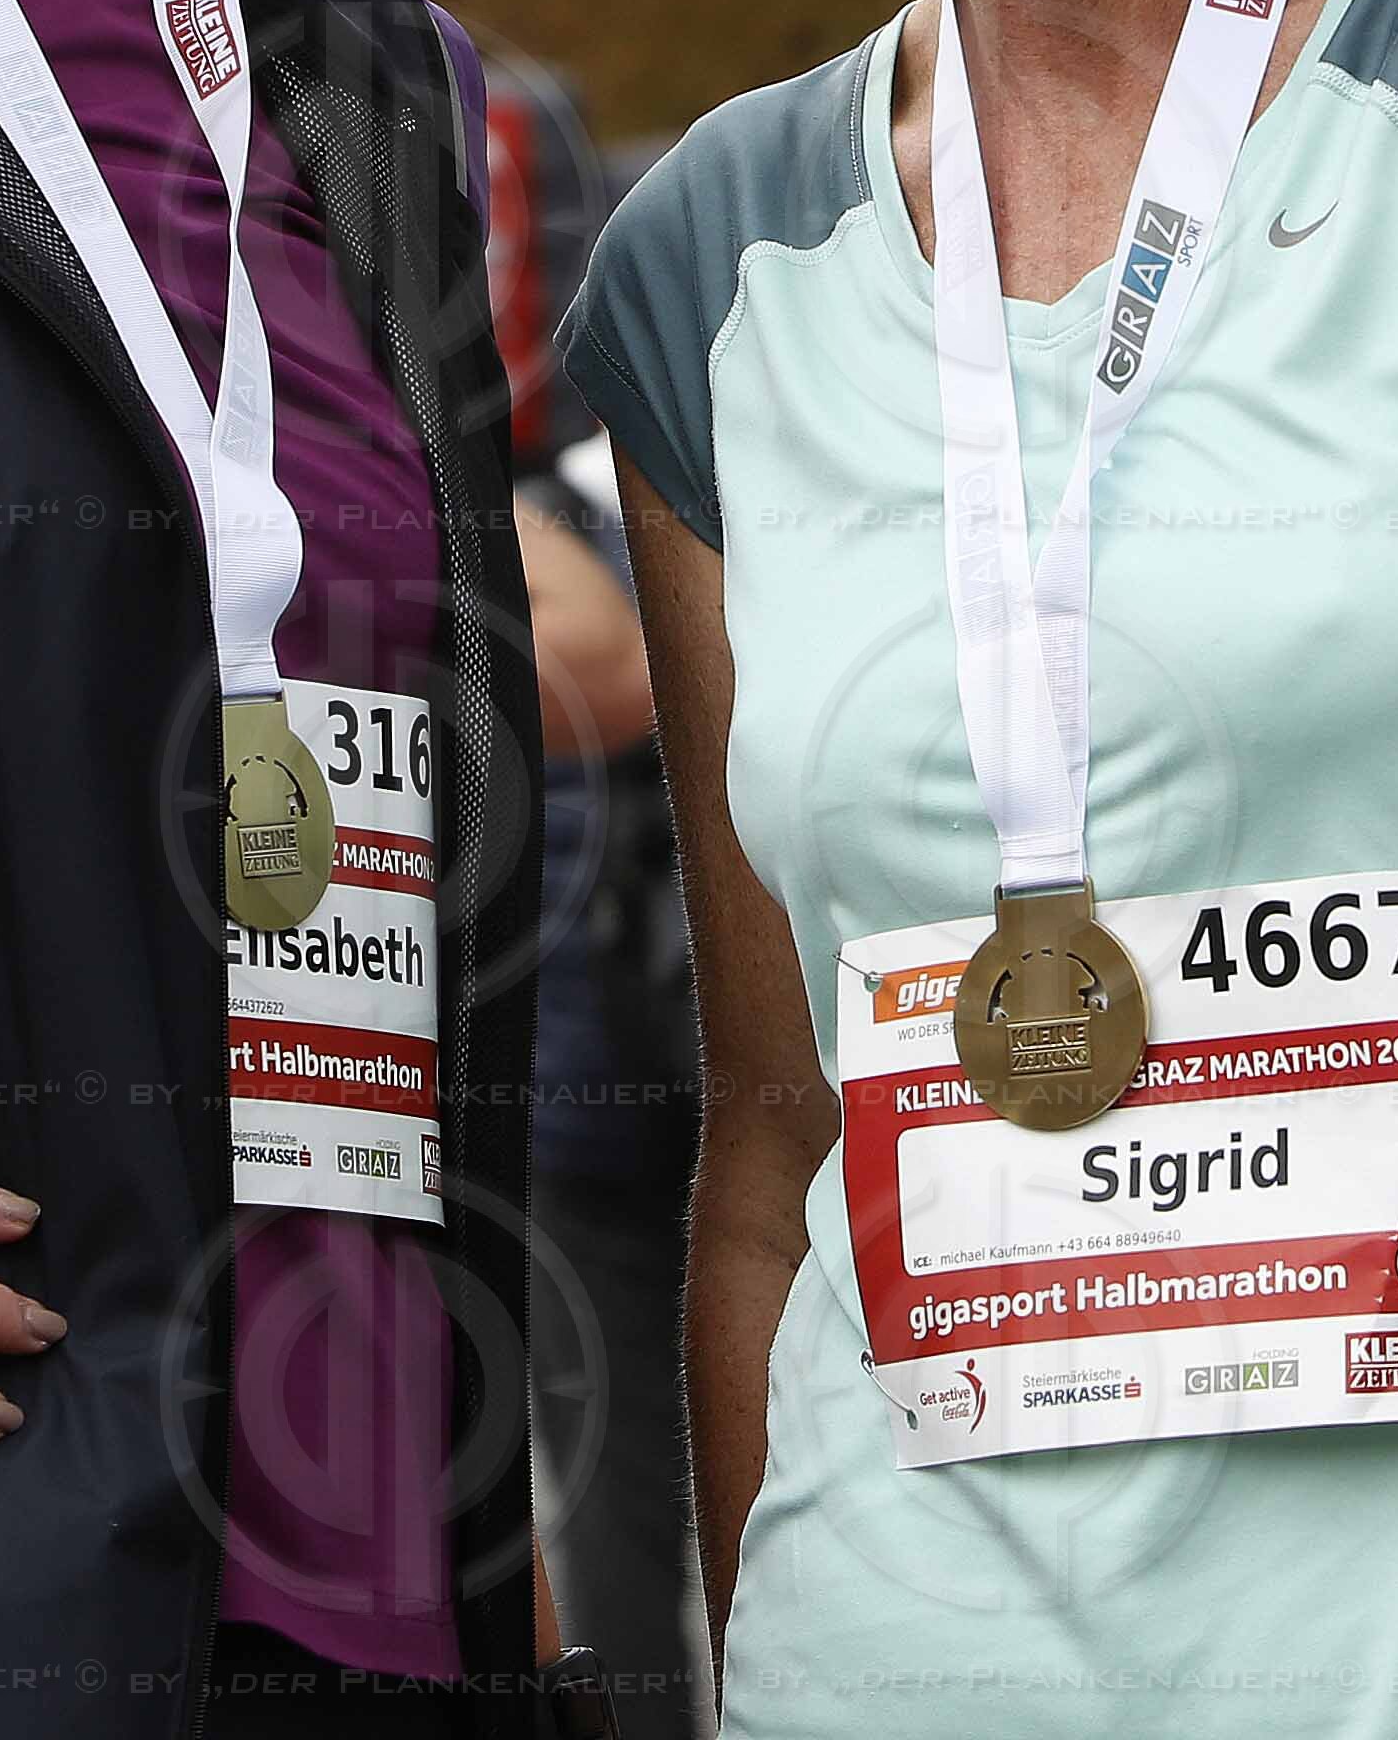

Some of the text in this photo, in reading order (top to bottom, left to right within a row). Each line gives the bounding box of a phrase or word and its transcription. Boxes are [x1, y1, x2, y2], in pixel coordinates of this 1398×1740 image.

[171, 0, 217, 93] ZEITUNG
[1177, 216, 1203, 267] SPORT
[1104, 207, 1182, 386] GRAZ
[243, 829, 298, 852] KLEINE
[245, 852, 301, 872] ZEITUNG
[343, 842, 431, 877] MARATHON
[897, 969, 962, 1013] giga
[897, 1026, 916, 1041] WO
[919, 1024, 941, 1039] DER
[1011, 1023, 1086, 1052] KLEINE
[230, 1040, 423, 1091] rt Halbmarathon
[1011, 1050, 1088, 1071] ZEITUNG
[1210, 1044, 1371, 1081] MARATHON
[232, 1144, 298, 1166] PARKASSE
[339, 1148, 401, 1179] GRAZ
[1082, 1128, 1289, 1211] Sigrid
[913, 1256, 932, 1269] ICE:
[940, 1247, 985, 1266] michael
[989, 1241, 1053, 1260] Kaufmann
[1058, 1238, 1083, 1253] +43
[1088, 1235, 1111, 1249] 664
[910, 1261, 1348, 1340] gigasport Halbmarathon
[1022, 1367, 1122, 1388] Steiermärkische
[1186, 1362, 1296, 1394] GRAZ
[920, 1387, 971, 1406] Get active
[1022, 1384, 1122, 1409] SPARKASSE
